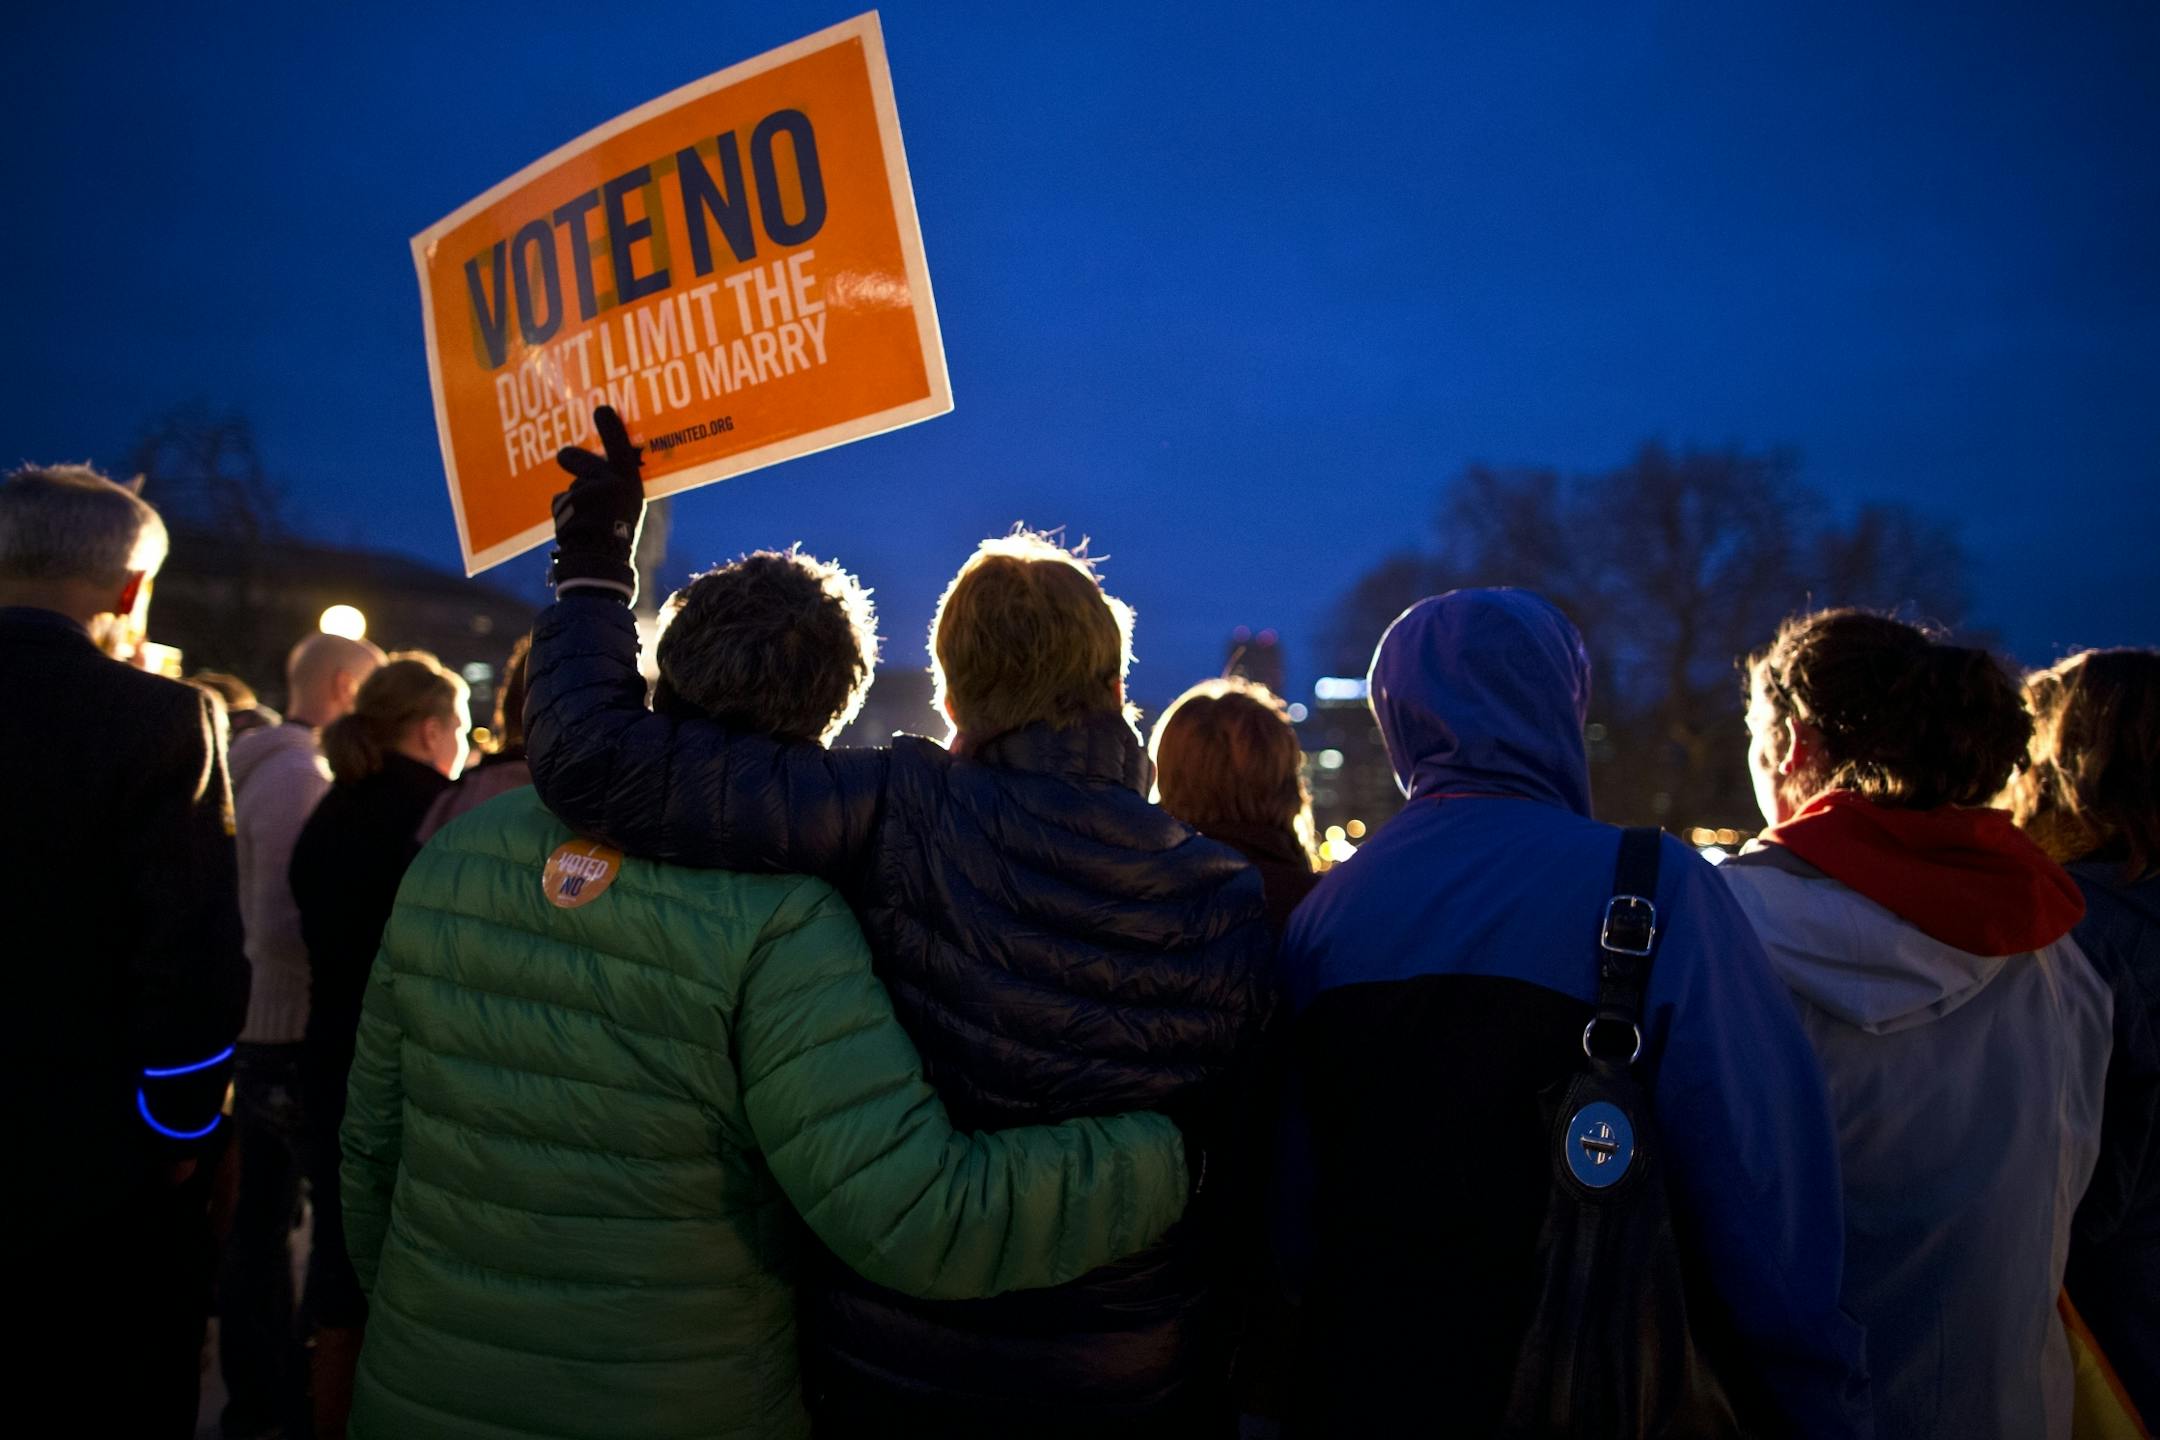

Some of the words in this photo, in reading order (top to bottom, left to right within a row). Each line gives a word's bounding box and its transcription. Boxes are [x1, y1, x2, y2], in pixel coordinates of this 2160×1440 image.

[463, 164, 672, 371] VOTE
[676, 108, 828, 278] NO
[495, 330, 593, 433] DON'T
[601, 285, 721, 380] LIMIT
[725, 250, 825, 339] THE
[641, 359, 692, 416] TO
[696, 314, 828, 400] MARRY
[649, 416, 735, 454] MNUNITED.ORG
[559, 853, 609, 881] VOTED
[560, 876, 586, 896] NO
